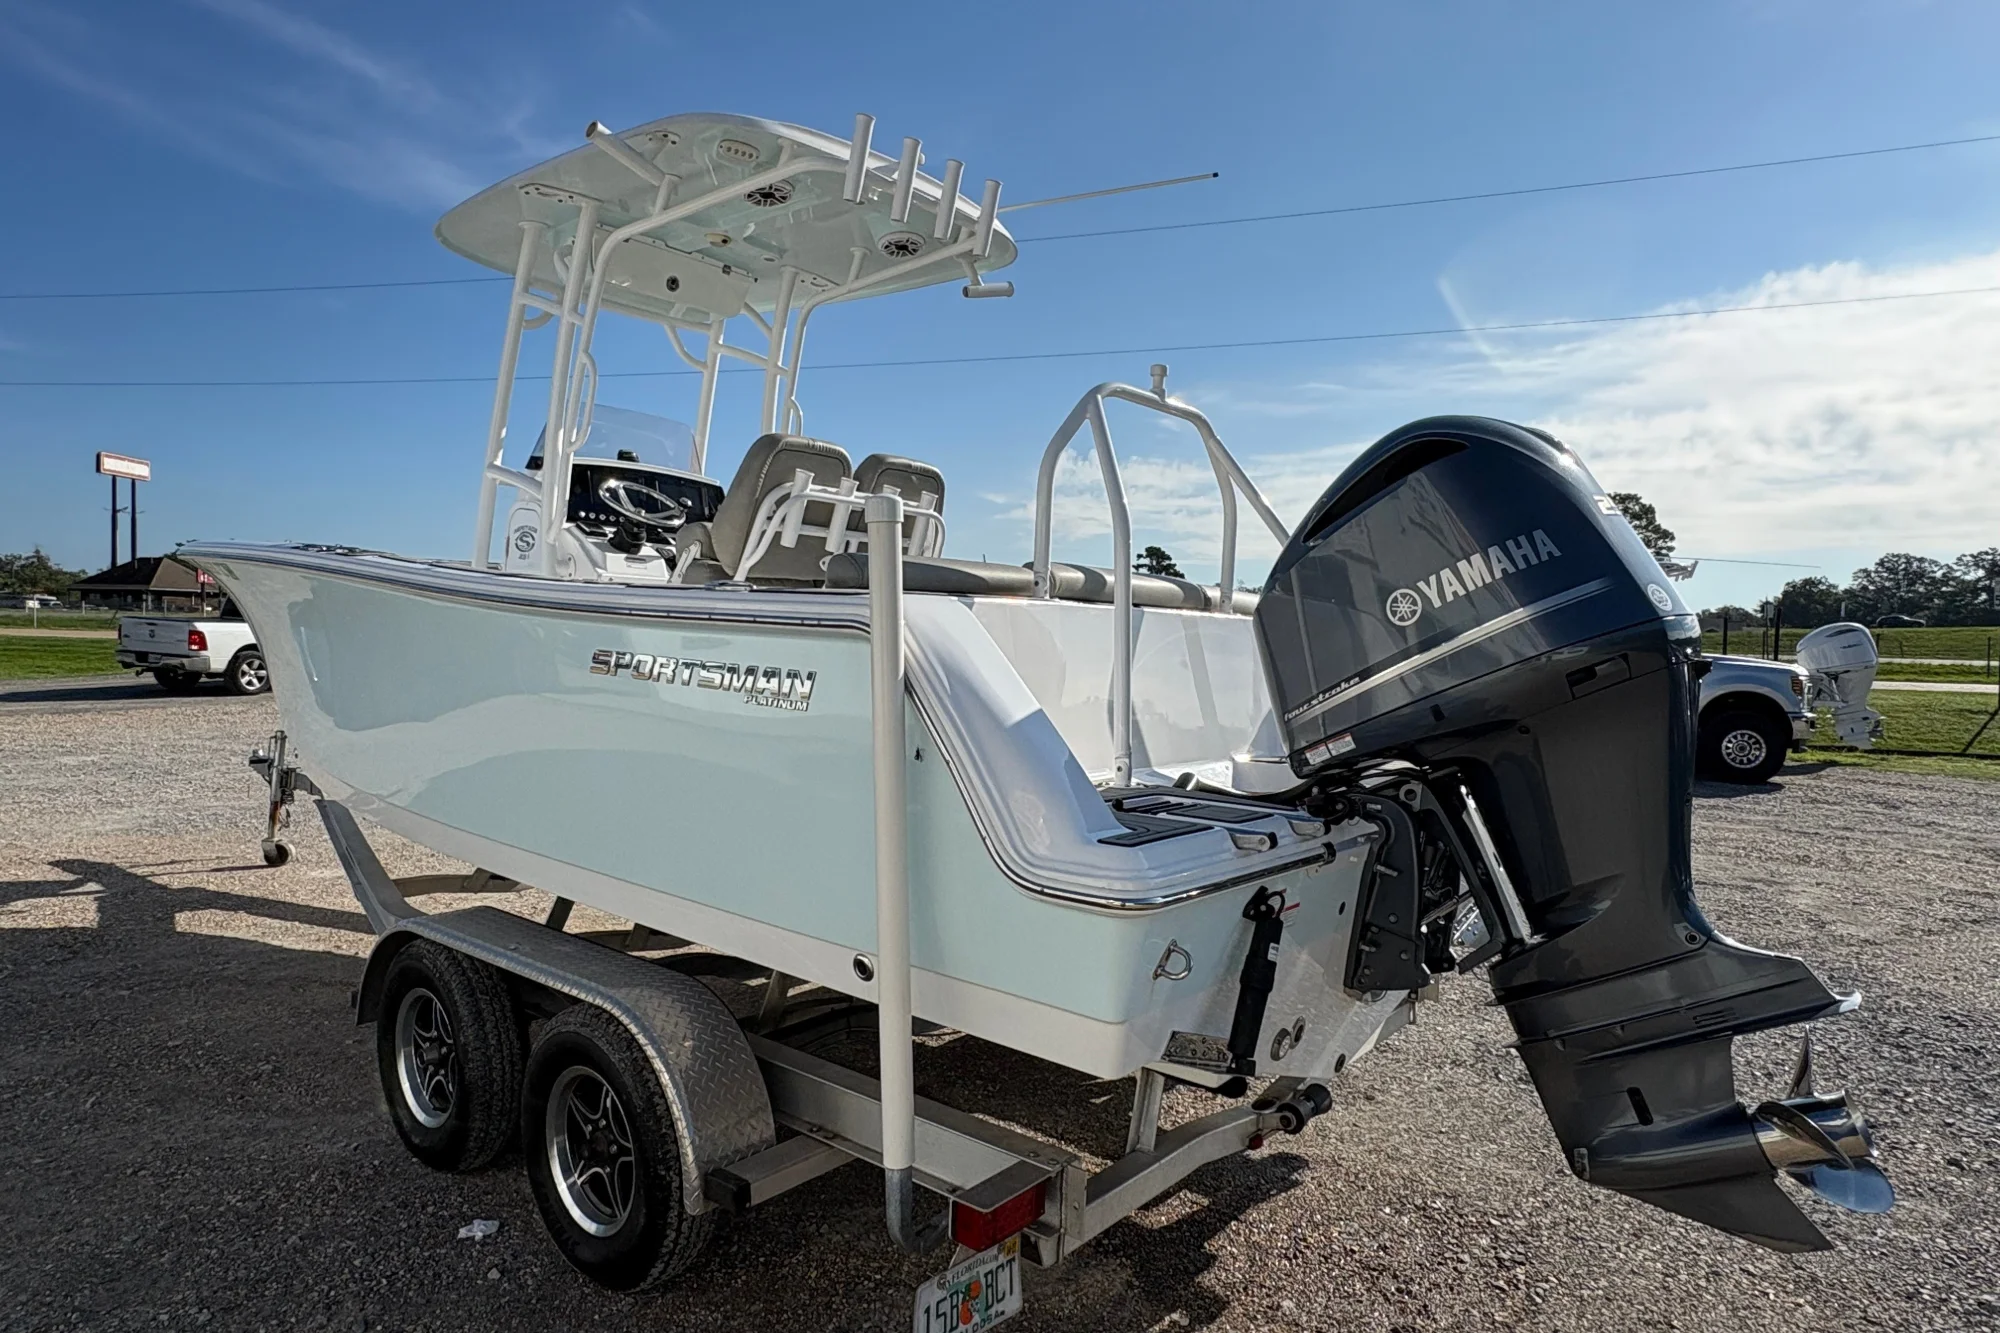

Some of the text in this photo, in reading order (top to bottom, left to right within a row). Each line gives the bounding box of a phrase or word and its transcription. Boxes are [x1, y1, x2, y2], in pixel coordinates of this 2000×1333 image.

[1416, 528, 1563, 609] YAMAHA
[590, 649, 817, 700] SPORTSMAN
[743, 695, 808, 711] PLATINUM
[984, 1256, 1016, 1312] BCT
